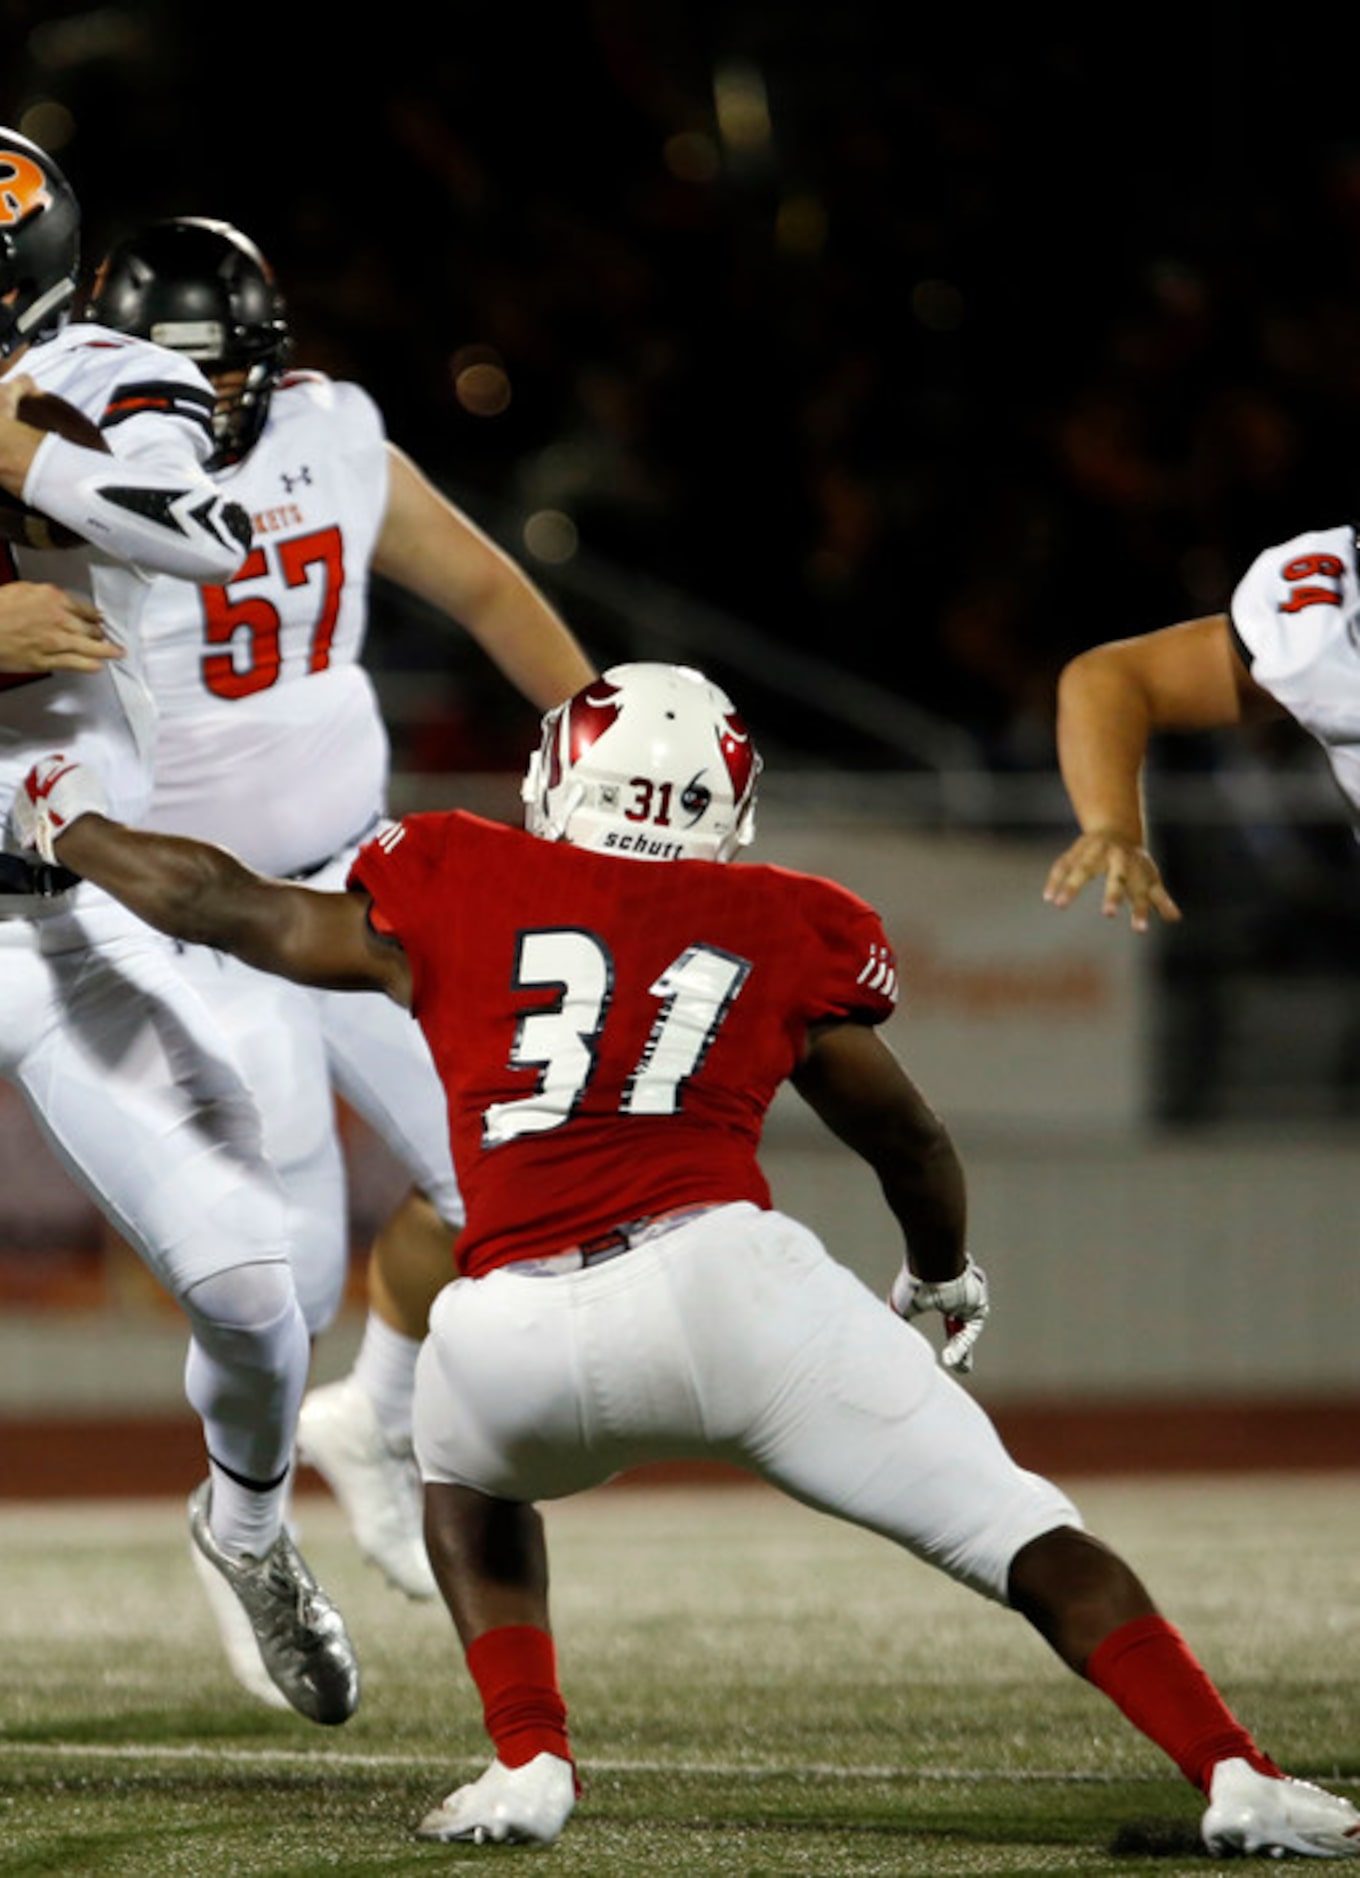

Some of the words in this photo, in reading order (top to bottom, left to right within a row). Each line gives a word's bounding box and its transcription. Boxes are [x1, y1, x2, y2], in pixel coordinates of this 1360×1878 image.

[200, 523, 345, 700] 57
[604, 831, 684, 860] schutt
[624, 776, 674, 827] 31
[481, 926, 753, 1149] 31
